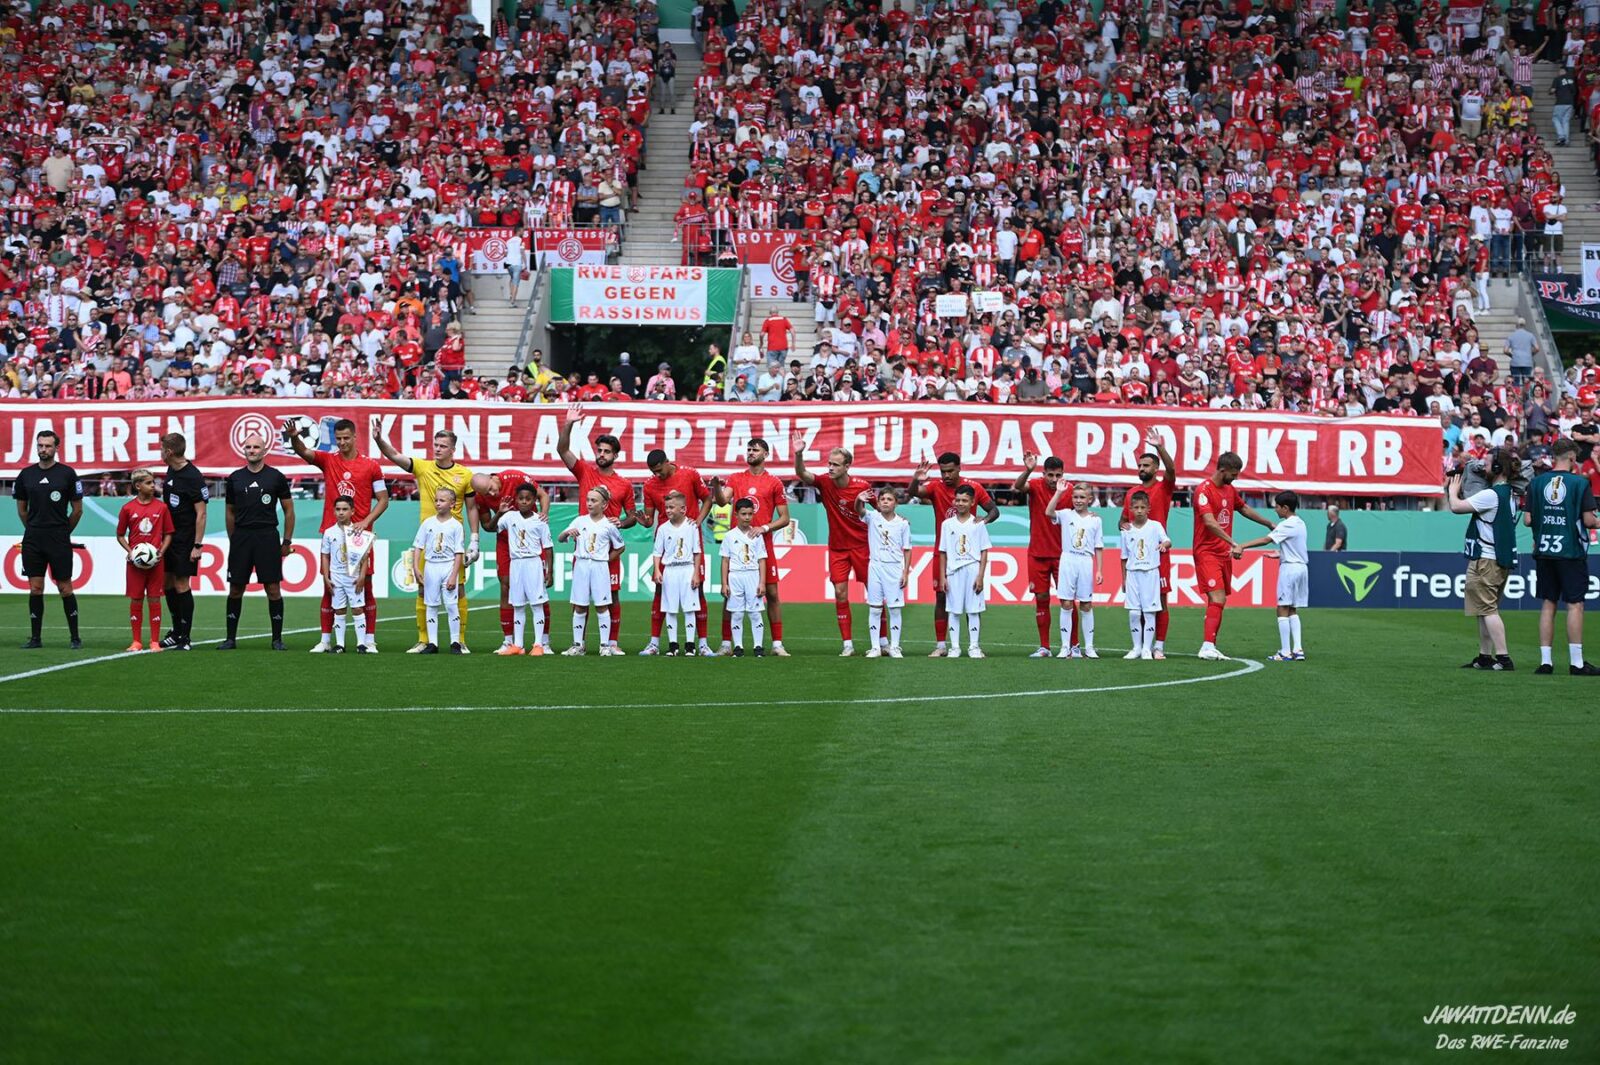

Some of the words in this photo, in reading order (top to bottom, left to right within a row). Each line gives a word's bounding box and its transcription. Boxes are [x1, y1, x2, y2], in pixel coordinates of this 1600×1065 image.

[578, 267, 621, 279] RWE
[650, 267, 703, 280] FANS
[605, 286, 676, 300] GEGEN
[579, 306, 701, 320] RASSISMUS
[532, 414, 822, 463] AKZEPTANZ
[843, 415, 940, 464] FÜR
[960, 418, 1054, 466] DAS
[1075, 421, 1318, 475] PRODUKT
[1338, 430, 1404, 477] RB
[1539, 534, 1565, 553] 53
